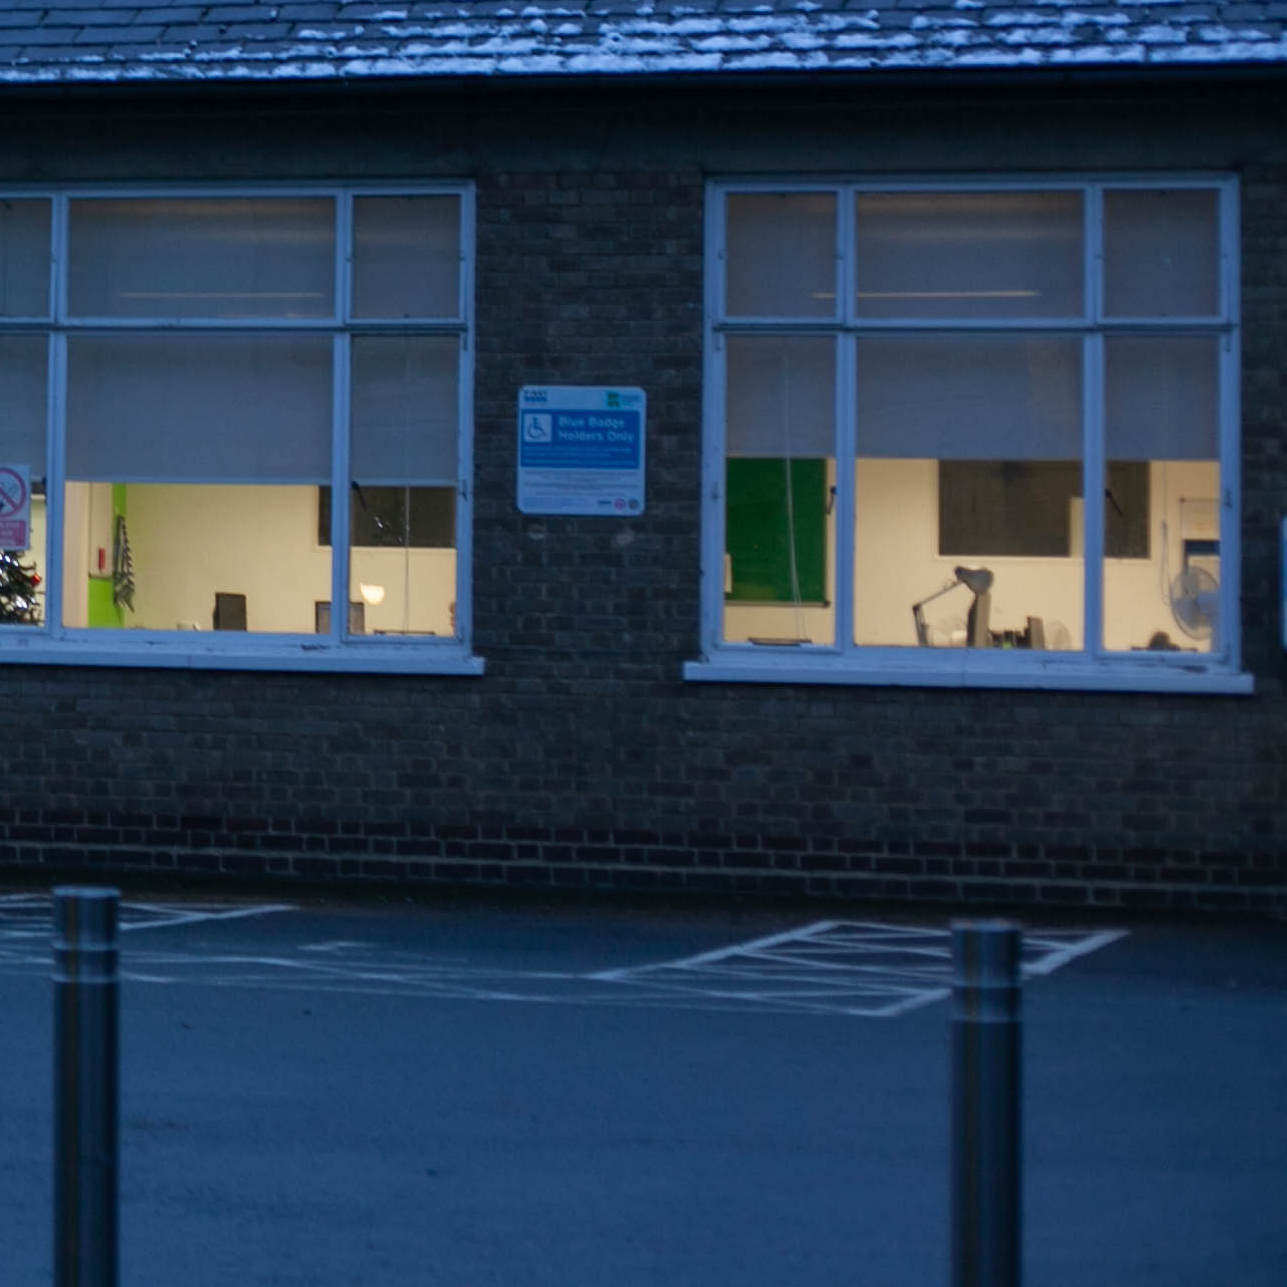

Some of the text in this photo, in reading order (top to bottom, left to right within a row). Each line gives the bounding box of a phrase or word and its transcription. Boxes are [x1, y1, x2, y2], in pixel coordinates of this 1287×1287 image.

[559, 416, 625, 431] Blue Badge
[558, 430, 635, 444] Holders Only
